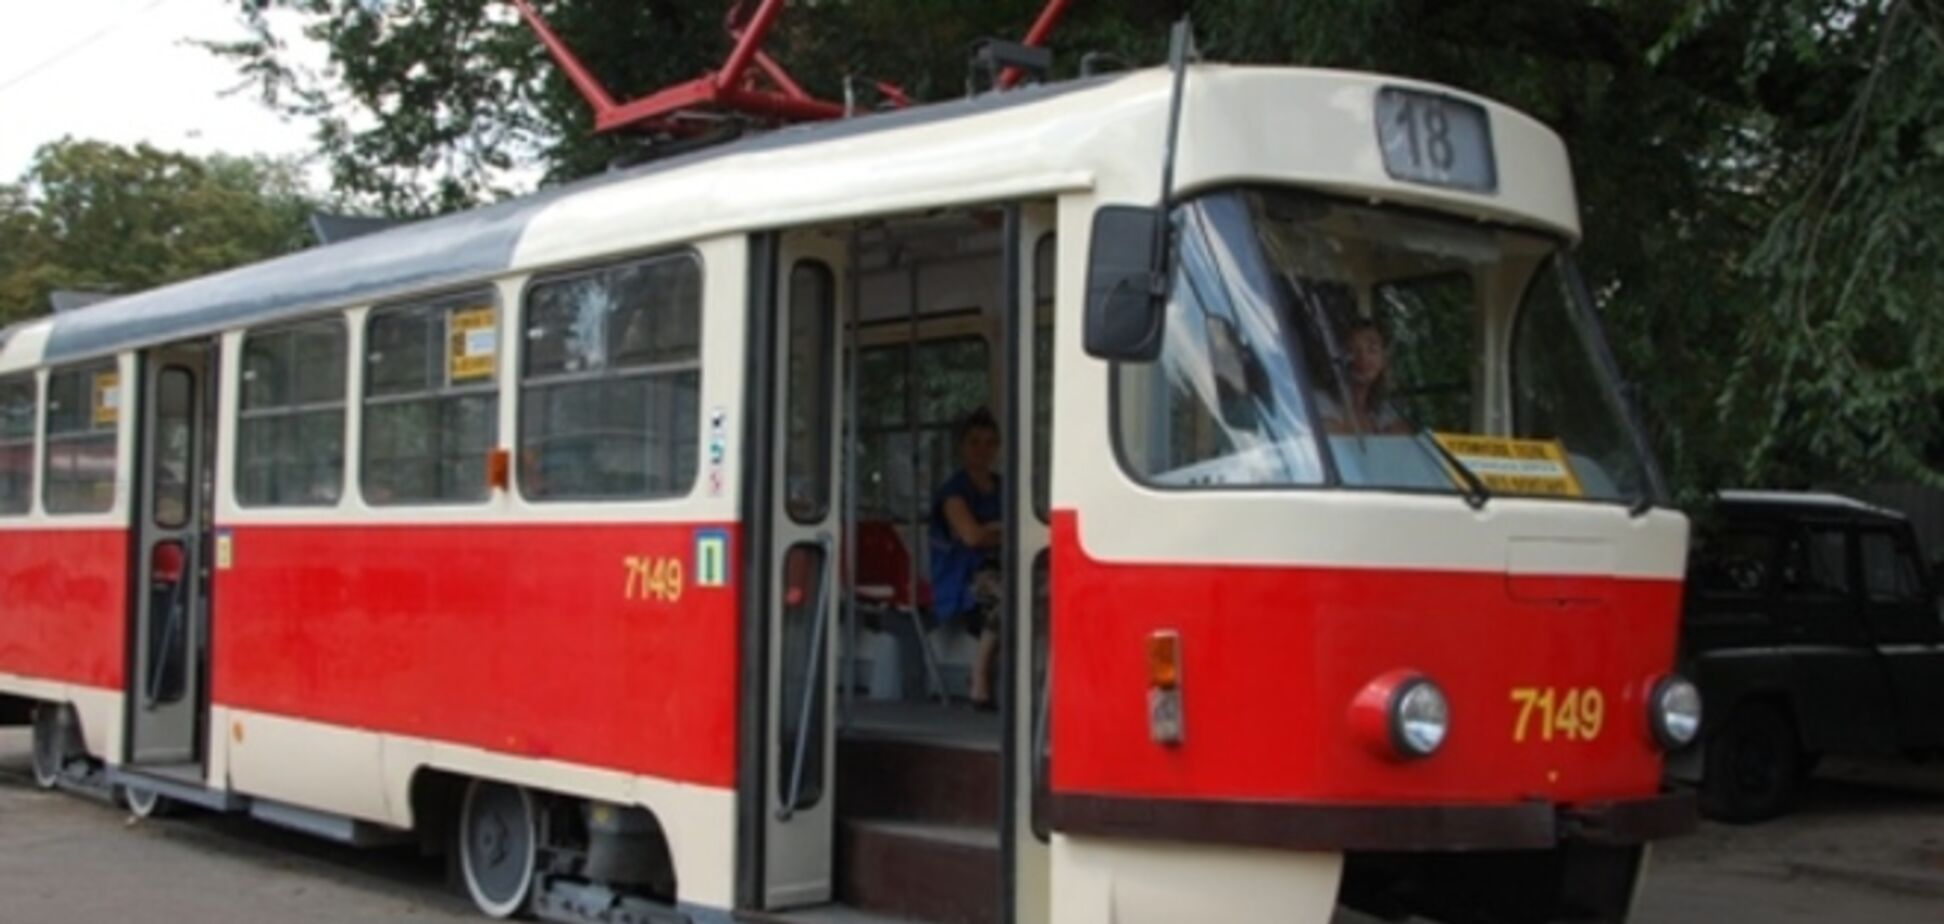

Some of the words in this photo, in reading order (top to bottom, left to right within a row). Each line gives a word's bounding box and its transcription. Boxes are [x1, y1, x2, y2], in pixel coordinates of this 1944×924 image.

[1395, 98, 1454, 171] 18
[623, 556, 683, 602] 7149
[1510, 687, 1604, 741] 7149
